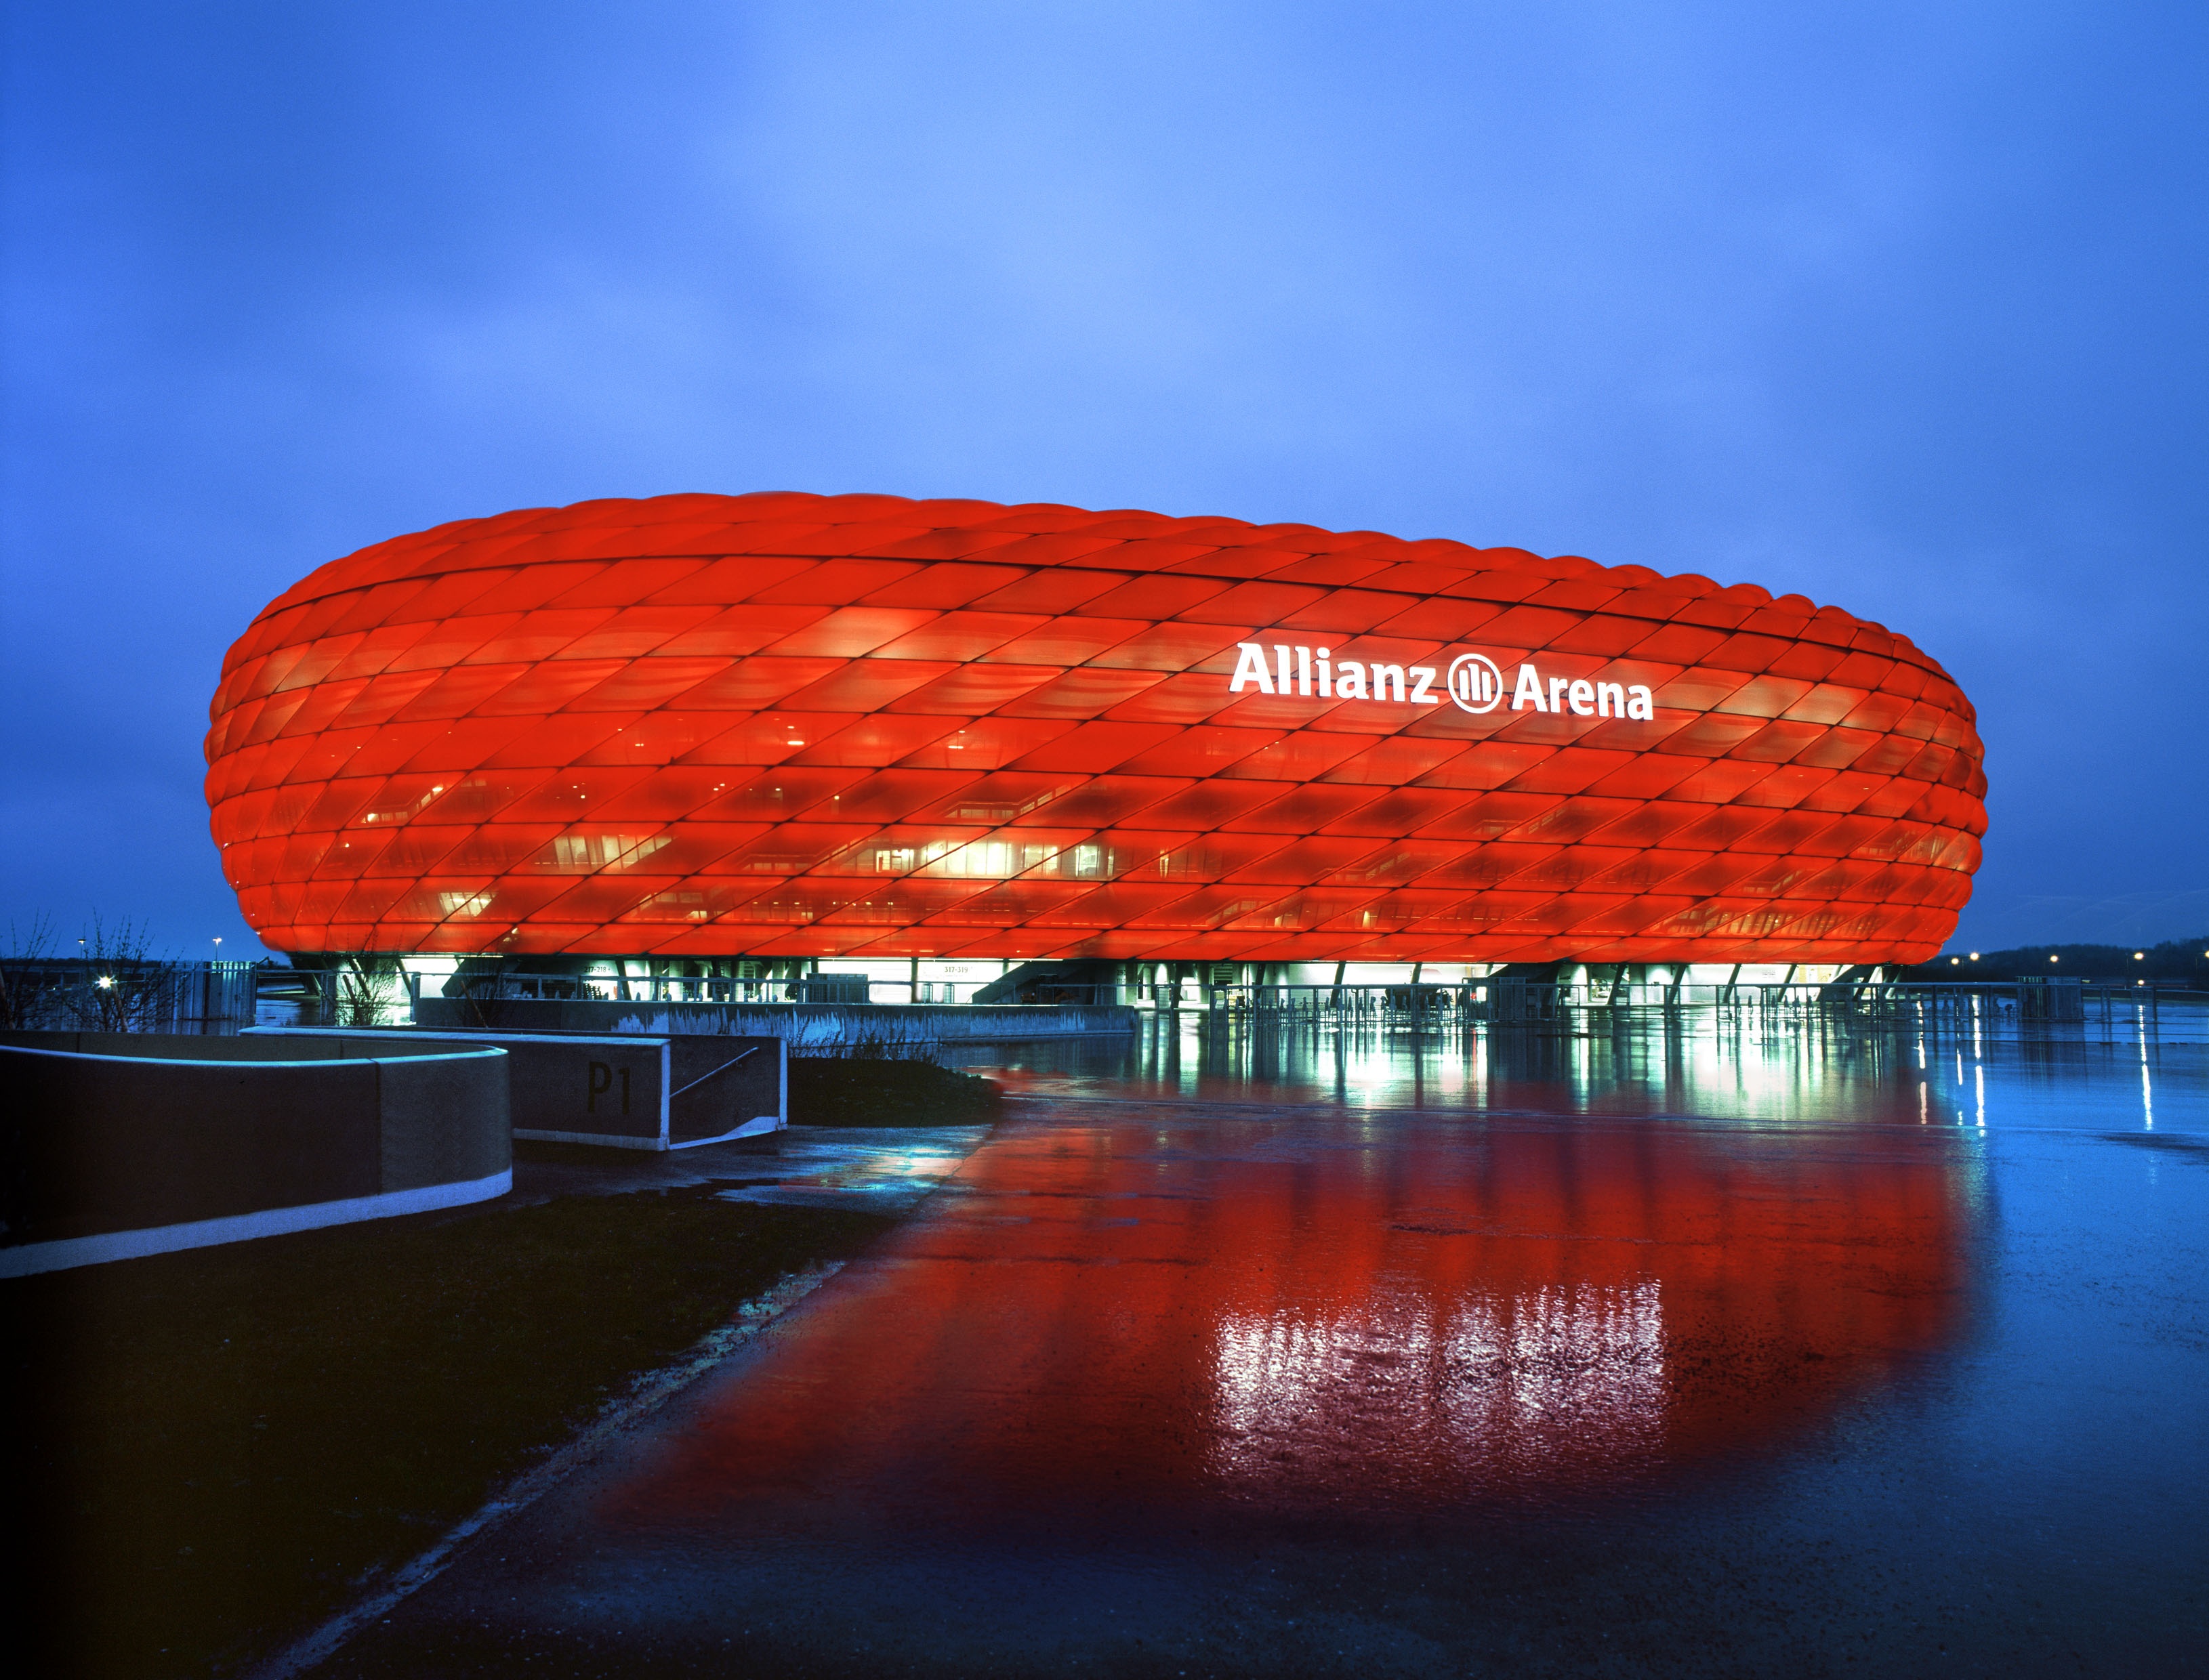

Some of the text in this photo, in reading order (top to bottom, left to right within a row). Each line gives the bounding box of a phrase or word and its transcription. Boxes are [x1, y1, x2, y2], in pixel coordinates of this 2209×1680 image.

[1229, 642, 1654, 721] Allianz Arena
[588, 1062, 630, 1114] P1
